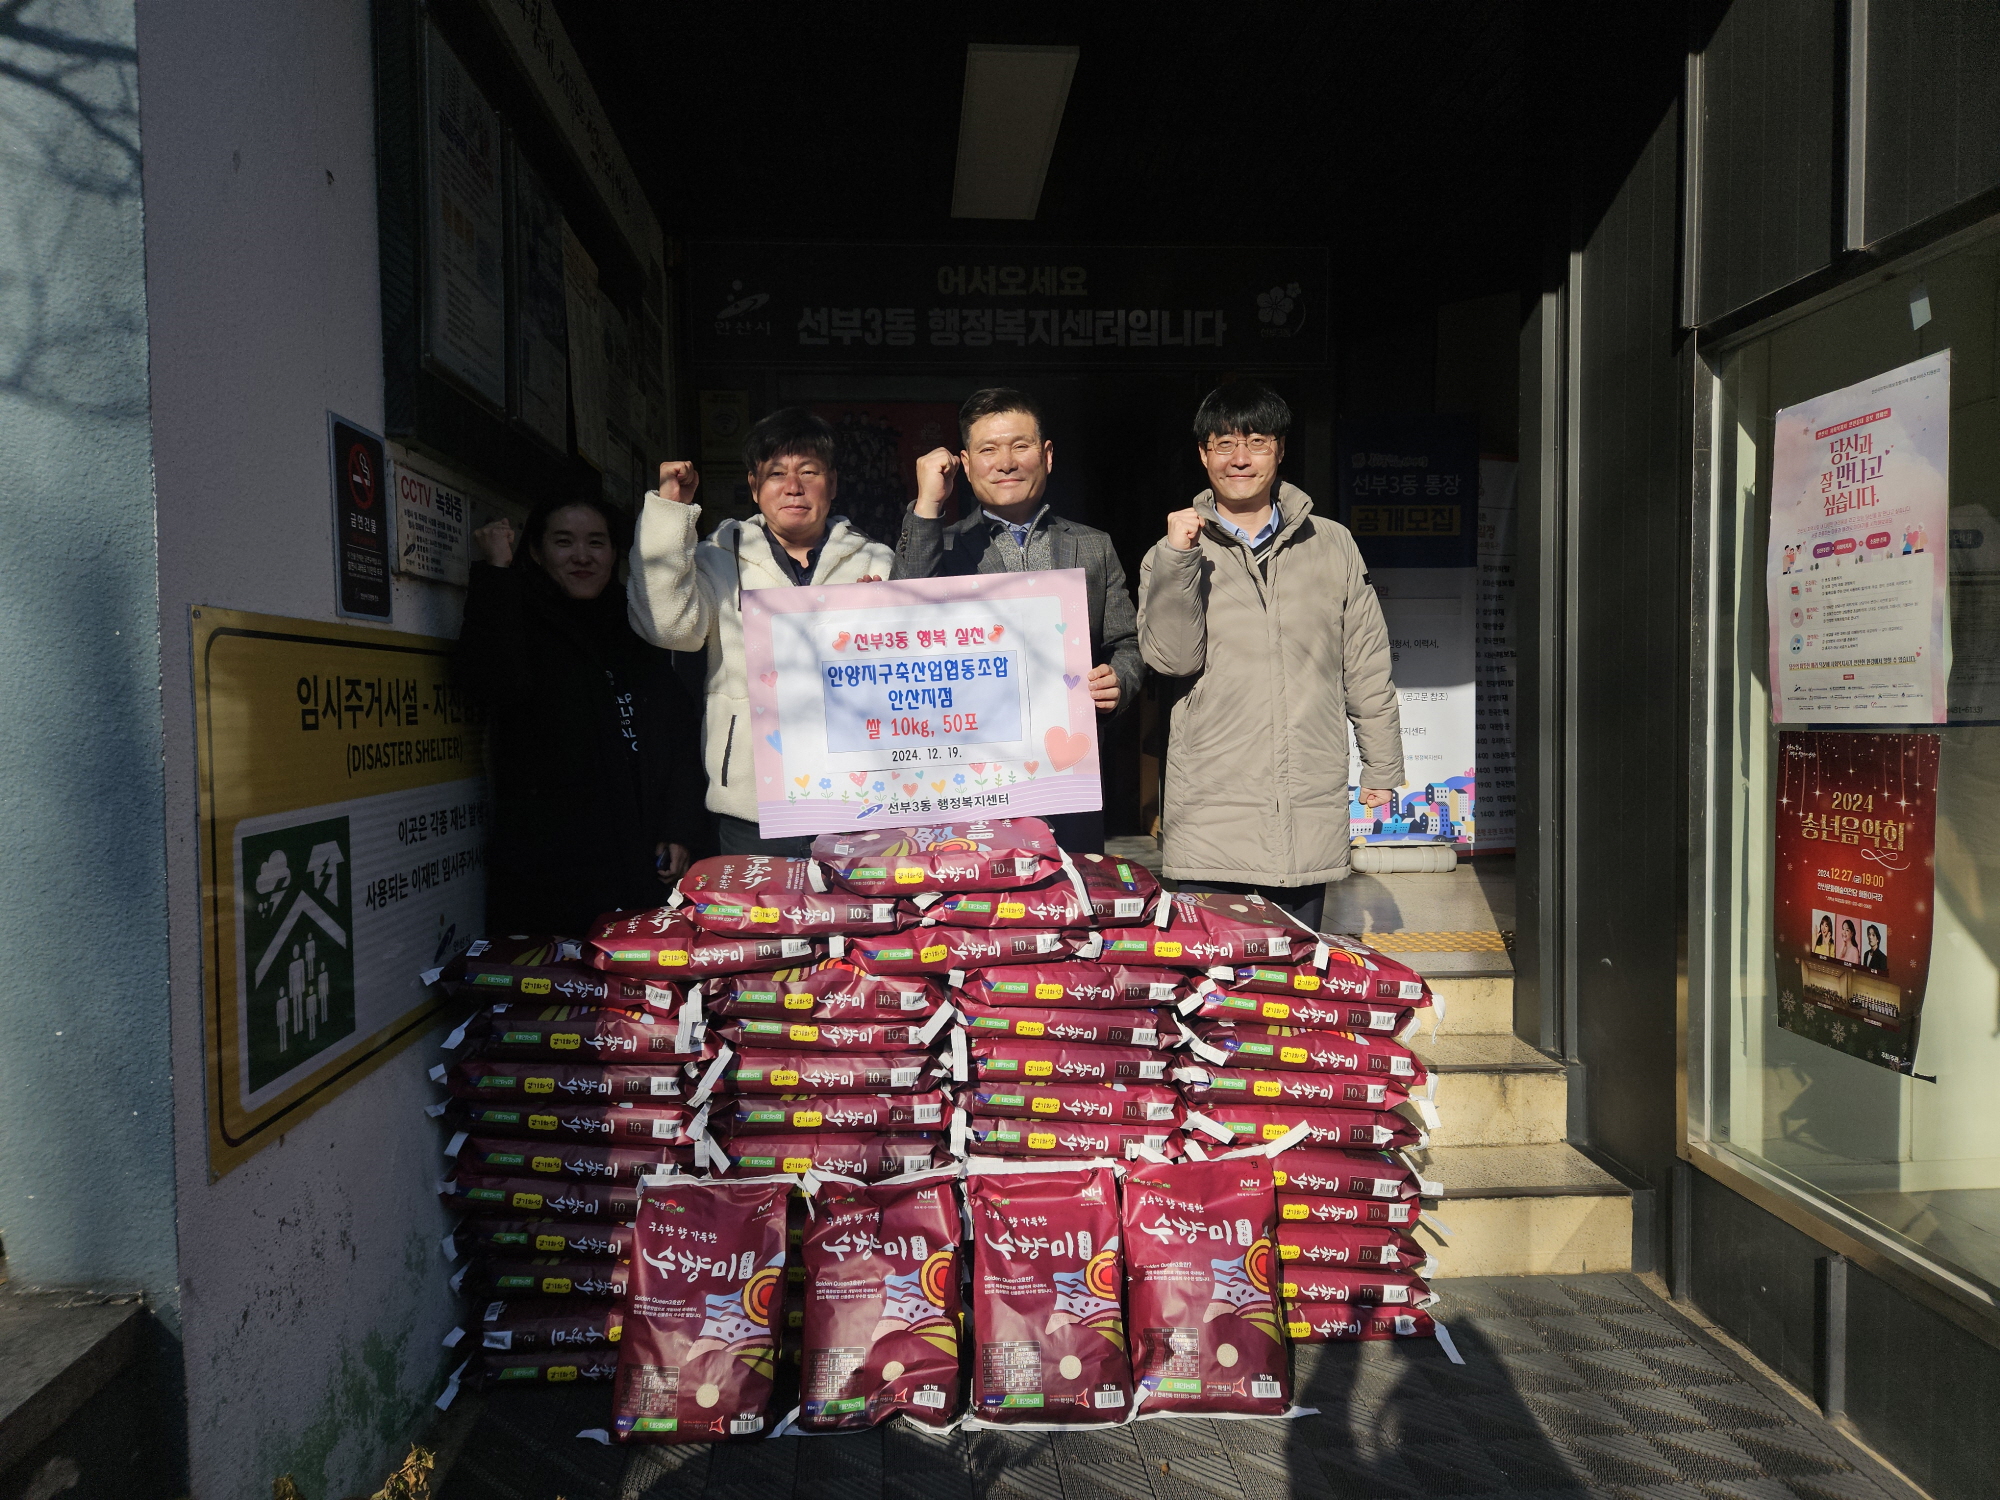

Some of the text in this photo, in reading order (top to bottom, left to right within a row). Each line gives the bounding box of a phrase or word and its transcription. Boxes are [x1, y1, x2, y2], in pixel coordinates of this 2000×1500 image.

[936, 264, 1089, 298] 어서오세요
[713, 319, 772, 337] 안산시
[797, 306, 1228, 348] 선부3동 행정복지센터입니다
[1829, 433, 1874, 465] 당신과
[1352, 473, 1462, 497] 선부3동 통장
[1820, 455, 1884, 494] 잘 만나고
[401, 475, 431, 508] CCTV
[435, 487, 463, 524] 녹화중
[1823, 485, 1880, 517] 싶습니다.
[350, 512, 377, 534] 금연건물
[1356, 507, 1455, 533] 공개모집
[853, 626, 986, 652] 선부3동 행복 실천
[1413, 639, 1439, 649] 이력서,
[827, 656, 1010, 688] 안양지구축산업협동조합
[296, 675, 419, 731] 임시주거시설
[888, 687, 954, 711] 안산지점
[1402, 692, 1449, 702] (공고문 참조)
[866, 713, 979, 741] 쌀 10kg, 50포
[346, 734, 464, 779] (DISASTER SHELTER)
[891, 747, 962, 762] 2024. 12. 19.
[887, 793, 1010, 815] 선부3동 행정복지센터
[1831, 791, 1874, 813] 2024
[398, 814, 428, 846] 이곳은
[429, 809, 448, 837] 각종
[449, 805, 466, 832] 재난
[1800, 812, 1906, 852] 송년음악회
[992, 863, 1005, 874] 10
[364, 873, 409, 911] 사용되는
[411, 859, 440, 893] 이재민
[1861, 872, 1884, 888] 19:00
[849, 908, 862, 919] 10
[758, 945, 771, 956] 10
[626, 1081, 638, 1092] 10
[891, 1110, 903, 1120] 10
[1081, 1187, 1102, 1198] NH
[1239, 1178, 1260, 1188] NH
[917, 1190, 938, 1199] NH
[1139, 1194, 1205, 1214] 구수한 향 가득한
[757, 1200, 774, 1214] NH
[1369, 1207, 1380, 1218] 10
[826, 1214, 852, 1226] 구수한
[854, 1212, 864, 1223] 향
[1008, 1215, 1019, 1228] 향
[1021, 1215, 1048, 1227] 가득한
[1139, 1213, 1233, 1245] 수향미
[648, 1222, 718, 1244] 구수한 향 가득한
[822, 1230, 908, 1262] 수향미
[984, 1230, 1075, 1260] 수향미
[642, 1245, 737, 1284] 수향미
